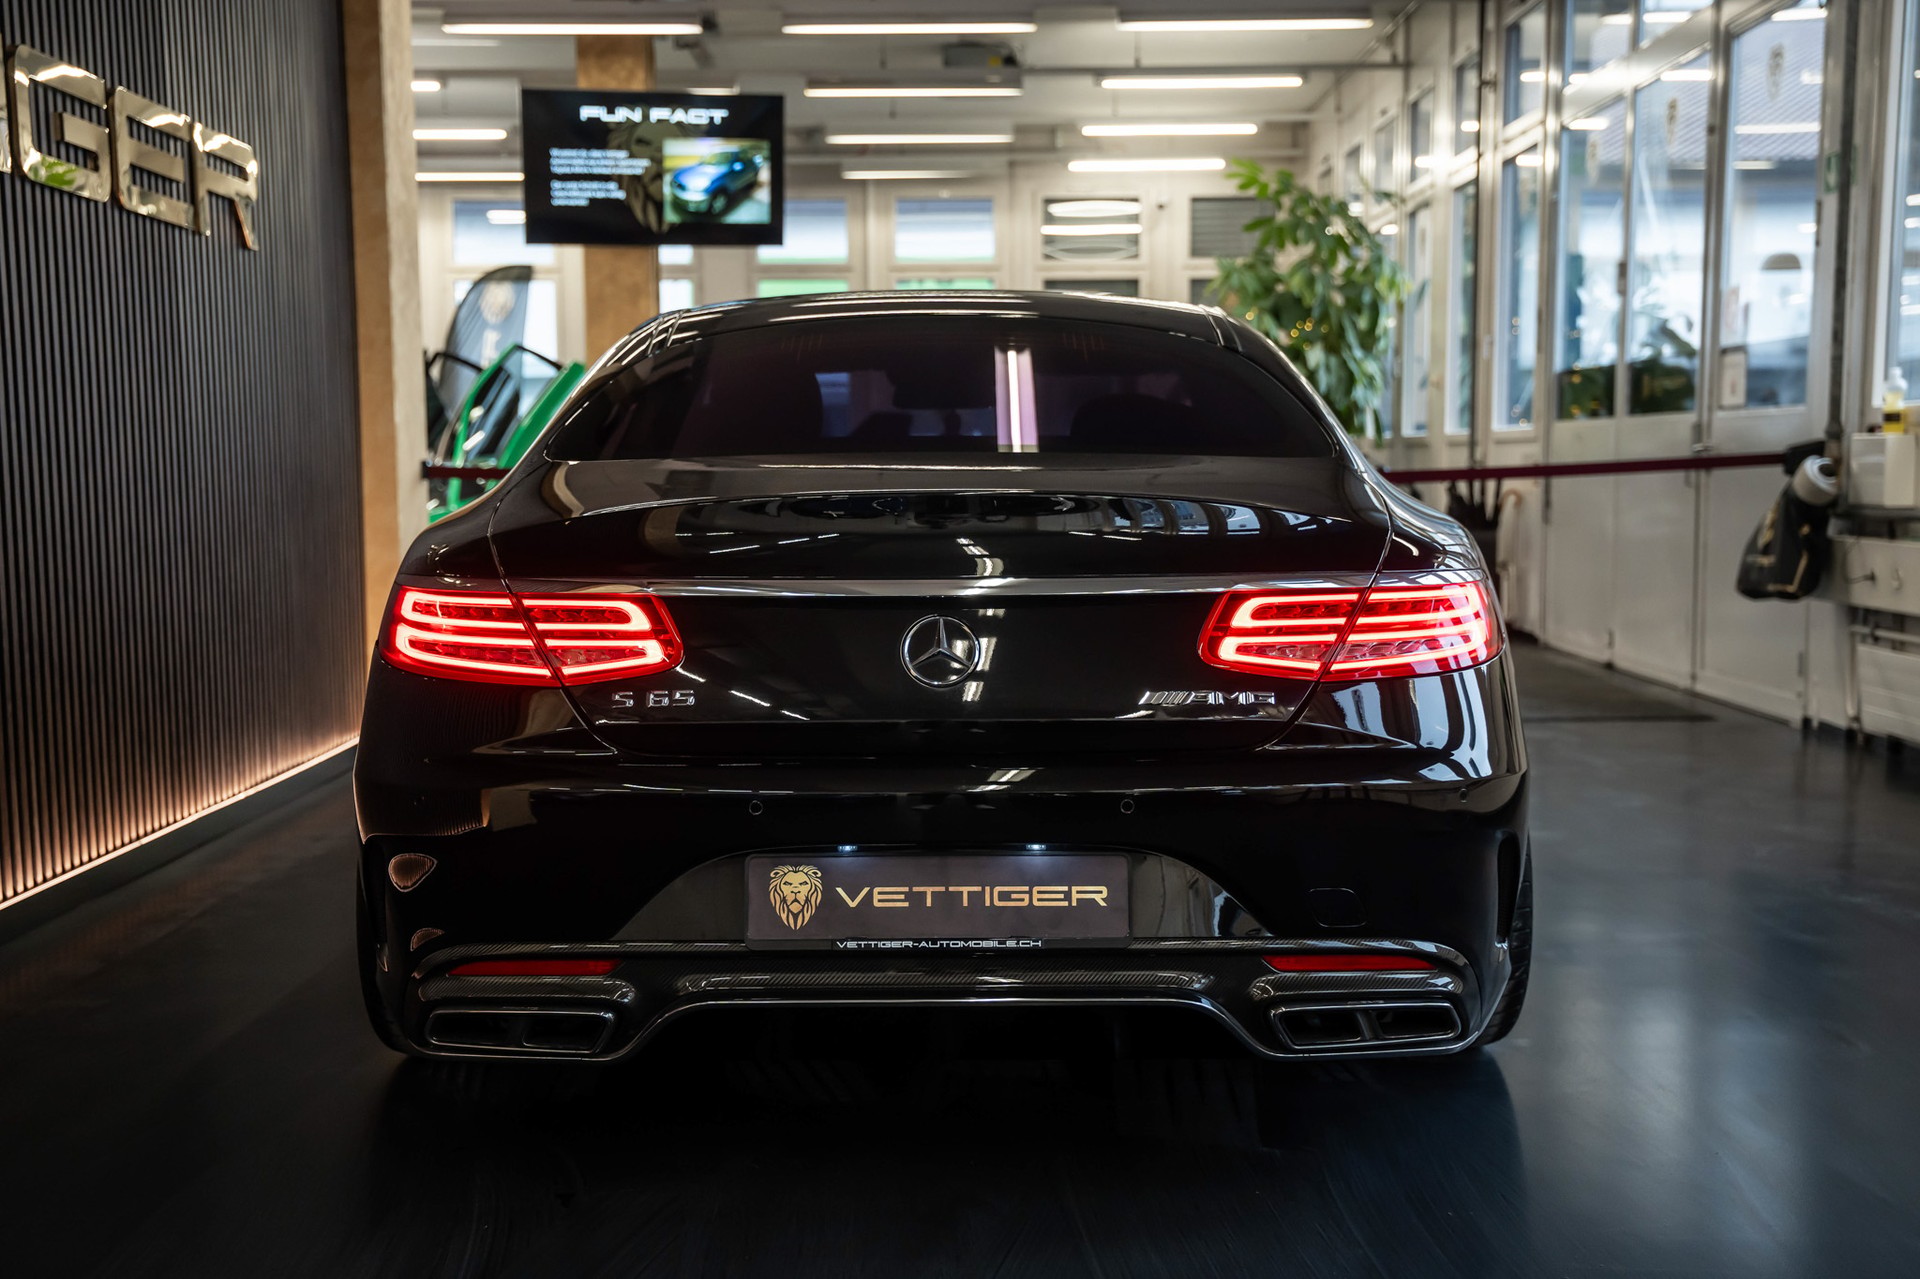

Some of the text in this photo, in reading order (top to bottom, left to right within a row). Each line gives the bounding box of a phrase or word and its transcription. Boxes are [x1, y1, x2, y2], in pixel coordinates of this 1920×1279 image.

[579, 105, 729, 125] FUN FACT
[612, 690, 695, 708] S 65
[1184, 690, 1275, 705] AMG
[835, 886, 1108, 908] VETTIGER
[836, 940, 1042, 949] VETTIGER-AUTOMOBILE.CH
